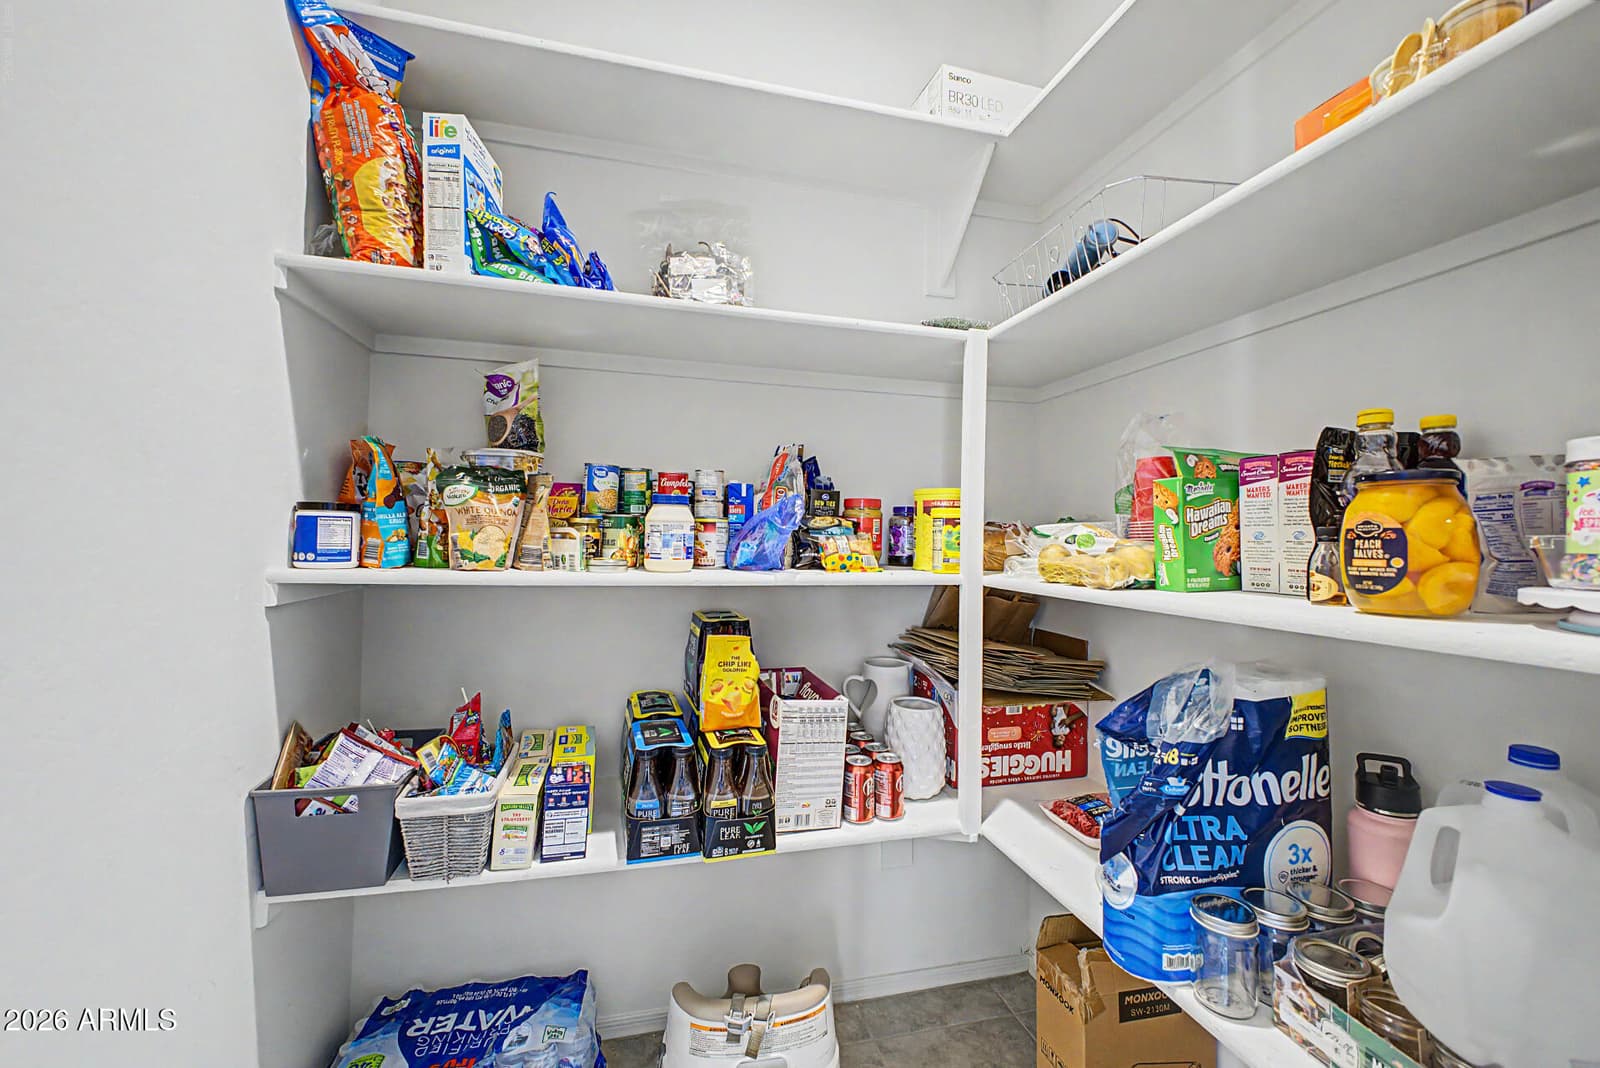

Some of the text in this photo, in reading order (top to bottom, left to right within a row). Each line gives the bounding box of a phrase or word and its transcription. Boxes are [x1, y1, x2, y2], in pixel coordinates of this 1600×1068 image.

[948, 73, 971, 84] Sunco
[948, 89, 978, 107] BR30
[981, 96, 1003, 112] LED
[429, 119, 457, 138] life
[455, 506, 480, 514] WHITE
[1186, 500, 1231, 520] Hawaiian
[1191, 515, 1227, 538] Dreams
[1353, 549, 1384, 558] HALVES
[1355, 539, 1381, 549] PEACH
[713, 808, 736, 816] PURE
[720, 826, 741, 834] PURE
[1162, 845, 1248, 871] CLEAN
[1288, 843, 1312, 865] 3x
[1160, 876, 1191, 885] STRONG
[1039, 975, 1075, 1015] MONXOOK
[406, 1005, 535, 1038] WATER
